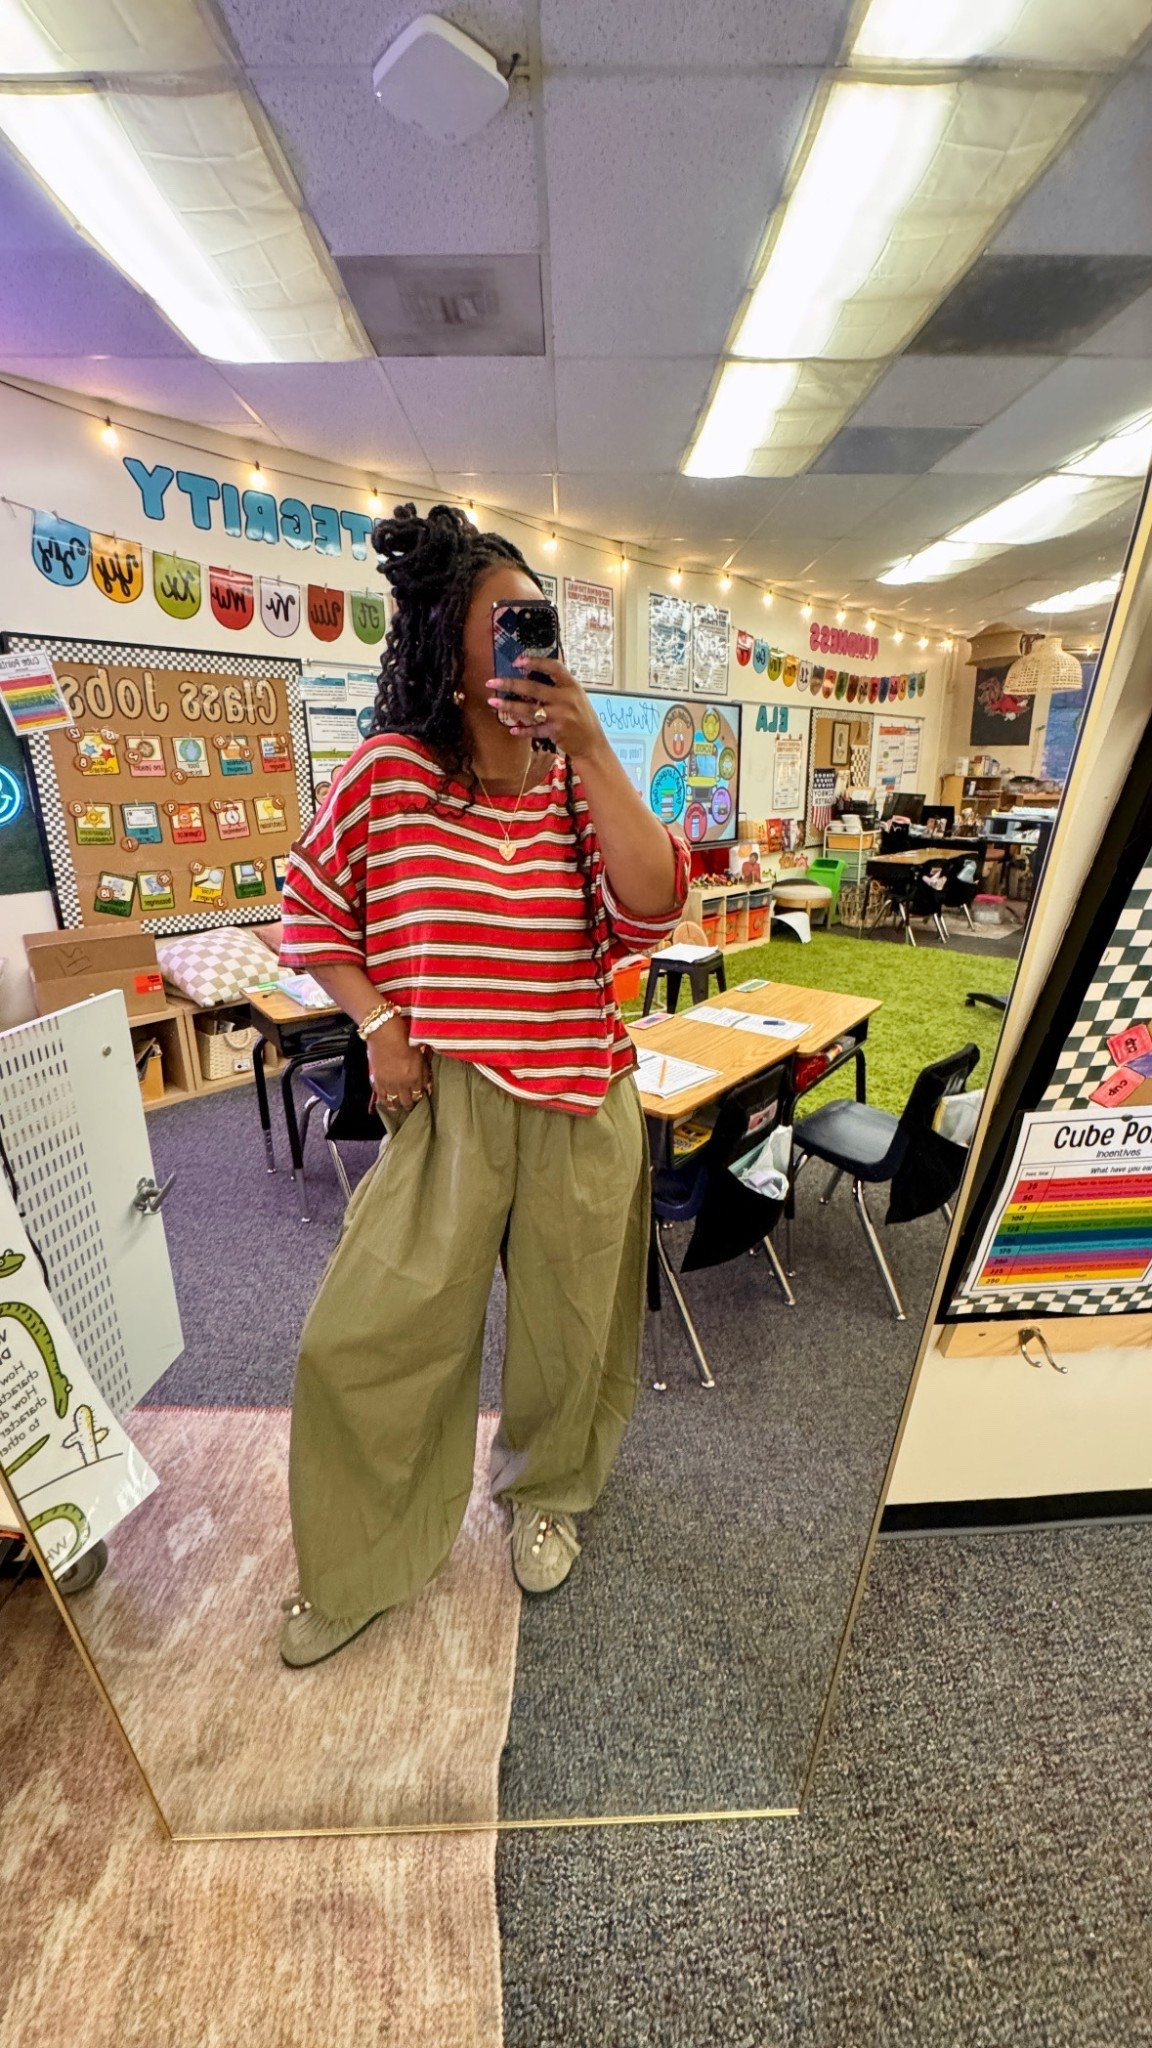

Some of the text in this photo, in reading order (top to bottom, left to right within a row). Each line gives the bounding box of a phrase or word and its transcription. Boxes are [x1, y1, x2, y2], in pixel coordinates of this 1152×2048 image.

[1108, 1079, 1128, 1096] cup
[1054, 1121, 1152, 1149] Cube Po
[1091, 1166, 1108, 1175] What
[1127, 1166, 1140, 1174] you
